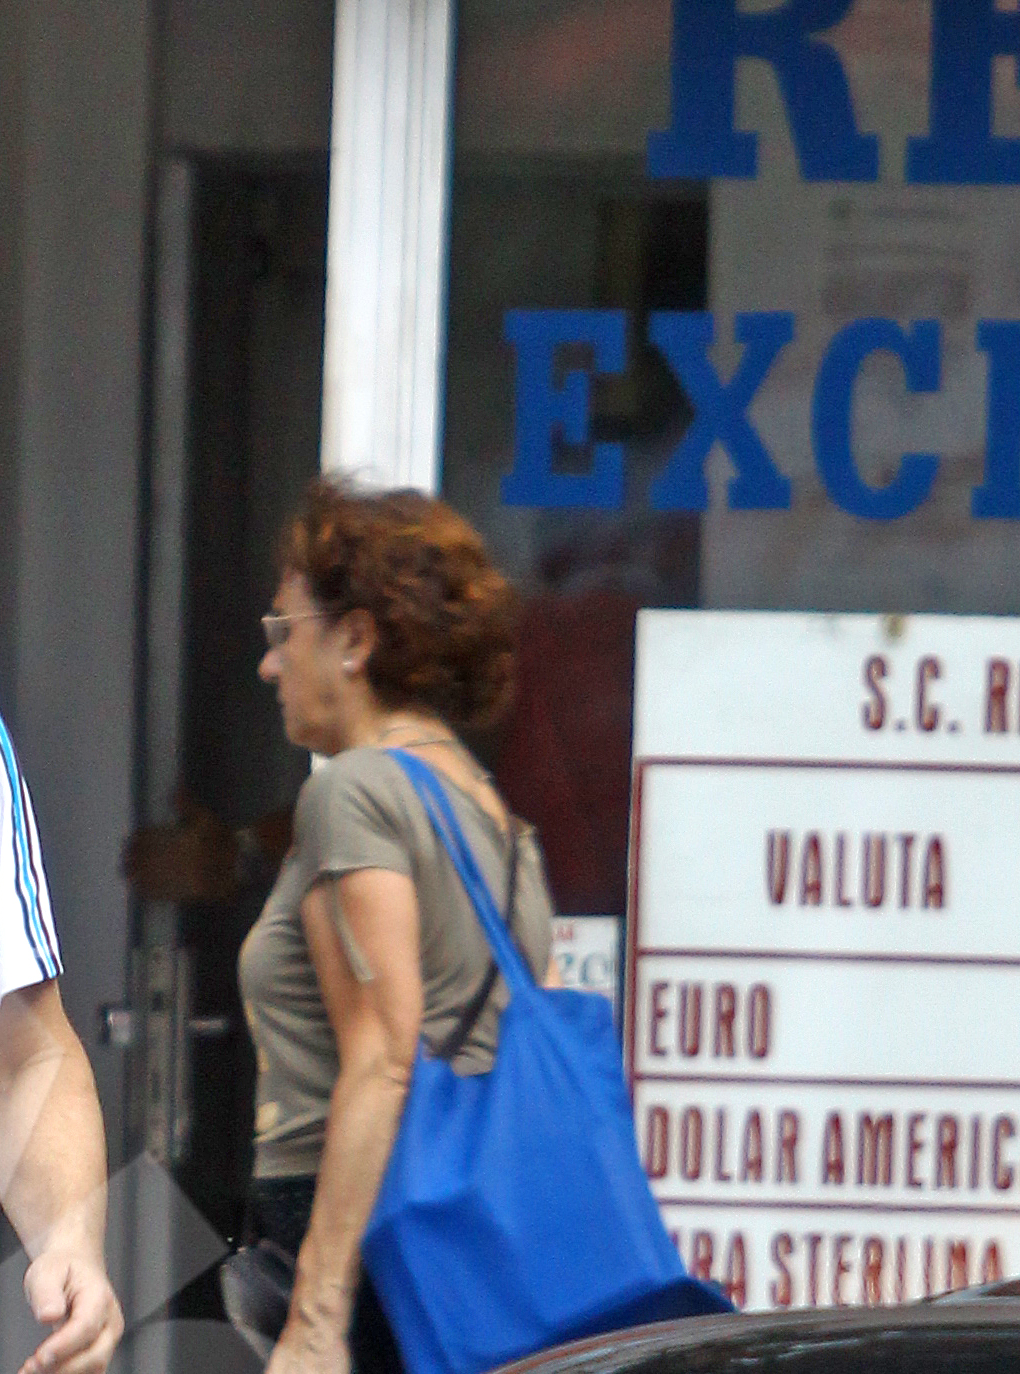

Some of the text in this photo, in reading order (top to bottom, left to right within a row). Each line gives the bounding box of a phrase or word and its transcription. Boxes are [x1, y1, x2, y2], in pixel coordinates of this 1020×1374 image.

[861, 655, 960, 733] S.C.
[765, 829, 949, 909] VALUTA
[649, 981, 773, 1059] EURO
[646, 1105, 1016, 1190] DOLAR AMERIC
